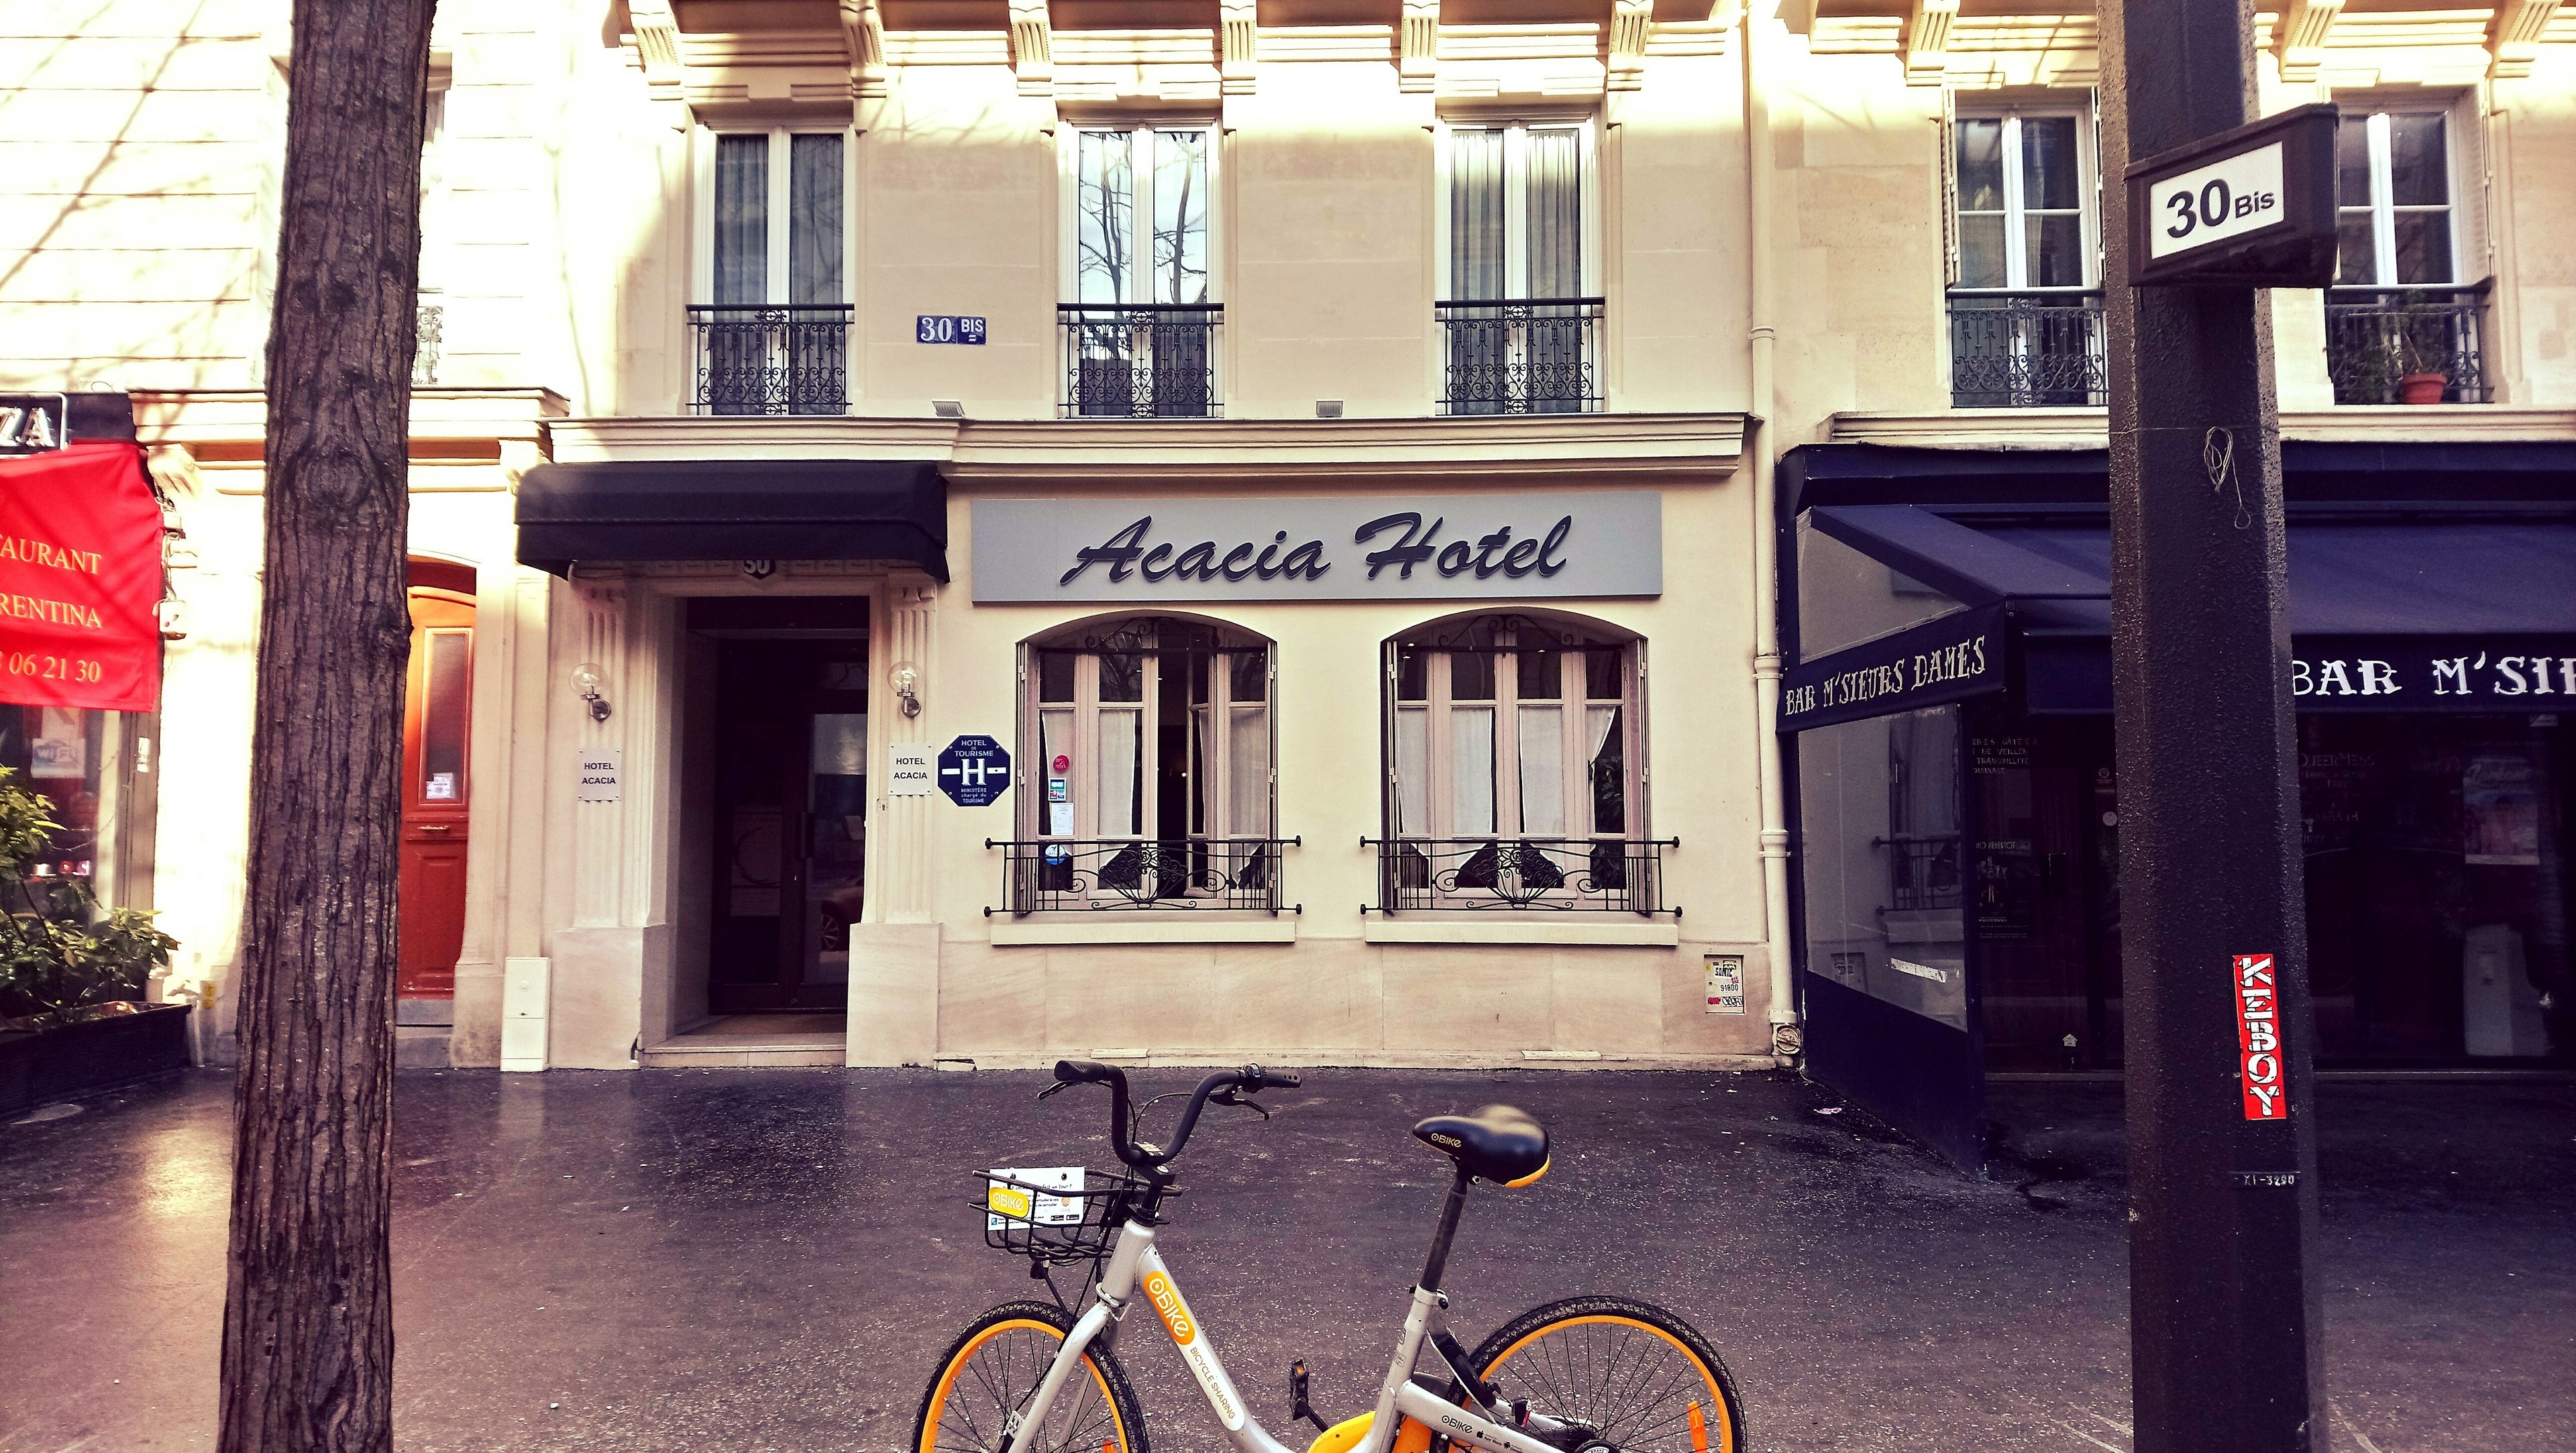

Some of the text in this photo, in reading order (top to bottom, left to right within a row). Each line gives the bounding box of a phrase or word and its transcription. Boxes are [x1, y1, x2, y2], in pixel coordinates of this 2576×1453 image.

[2167, 178, 2275, 238] 30 Bis
[920, 317, 983, 341] 30 BIS
[0, 534, 101, 575] AURANT
[1059, 511, 1574, 586] Acacia Hotel
[0, 592, 102, 629] RENTINA
[9, 652, 101, 682] 06 21 30
[1785, 635, 1986, 716] BAR M'SIEURS DAMES
[2292, 659, 2402, 696] BAR
[961, 758, 987, 786] H
[2239, 957, 2279, 1116] KEBOY
[1190, 1346, 1235, 1419] BICYCLE SHARING
